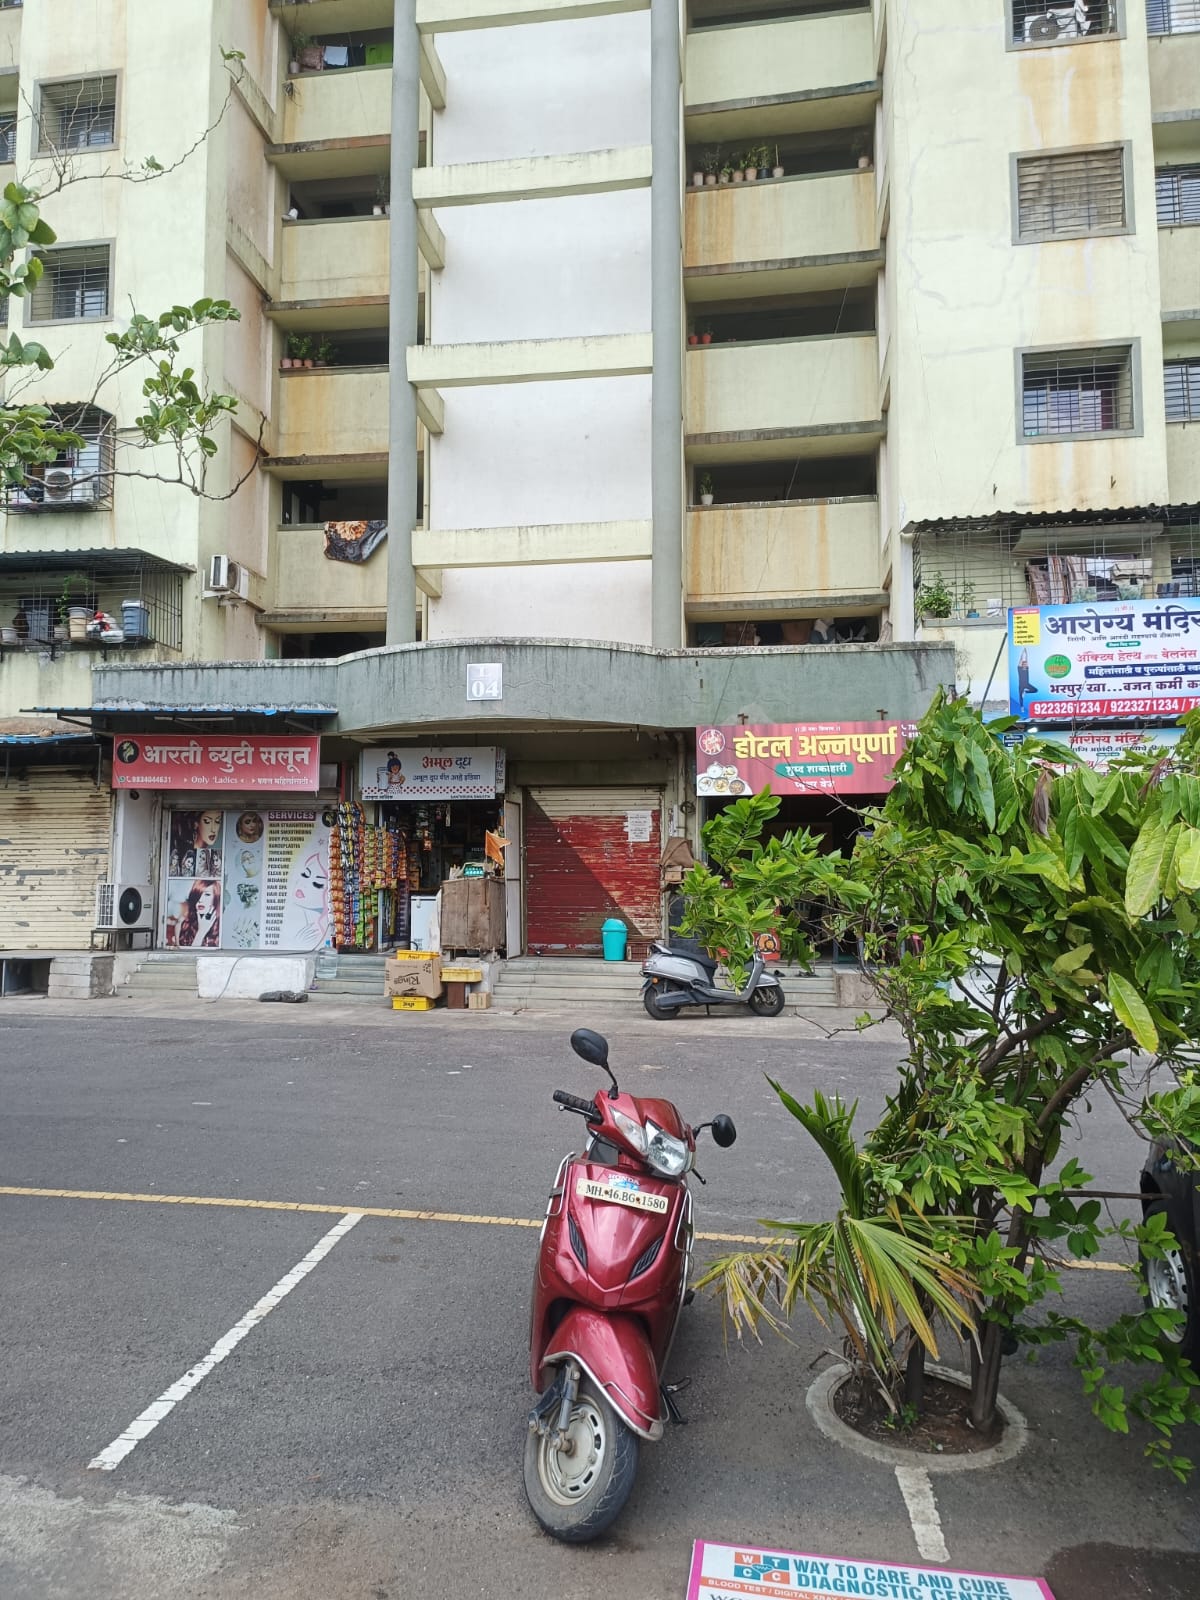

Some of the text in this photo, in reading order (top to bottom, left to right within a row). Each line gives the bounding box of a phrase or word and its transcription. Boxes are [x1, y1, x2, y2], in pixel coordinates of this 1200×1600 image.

[1045, 608, 1135, 635] आरोग्य
[1155, 676, 1183, 690] कमी
[1034, 701, 1100, 715] 9223261234
[1110, 698, 1179, 713] 9223271234
[732, 725, 897, 764] होटल अन्नपूर्णा
[142, 740, 311, 773] आरती ब्युटी सलून
[455, 757, 472, 770] दूध
[191, 776, 209, 784] Only
[269, 811, 314, 819] SERVICES
[607, 1173, 640, 1185] HONDA
[793, 1559, 1010, 1595] WAY TO CARE AND CURE
[797, 1573, 923, 1600] DIAGNOSTIC
[708, 1579, 741, 1590] BLOOD
[744, 1584, 767, 1593] TEST
[774, 1589, 808, 1600] DIGITAL
